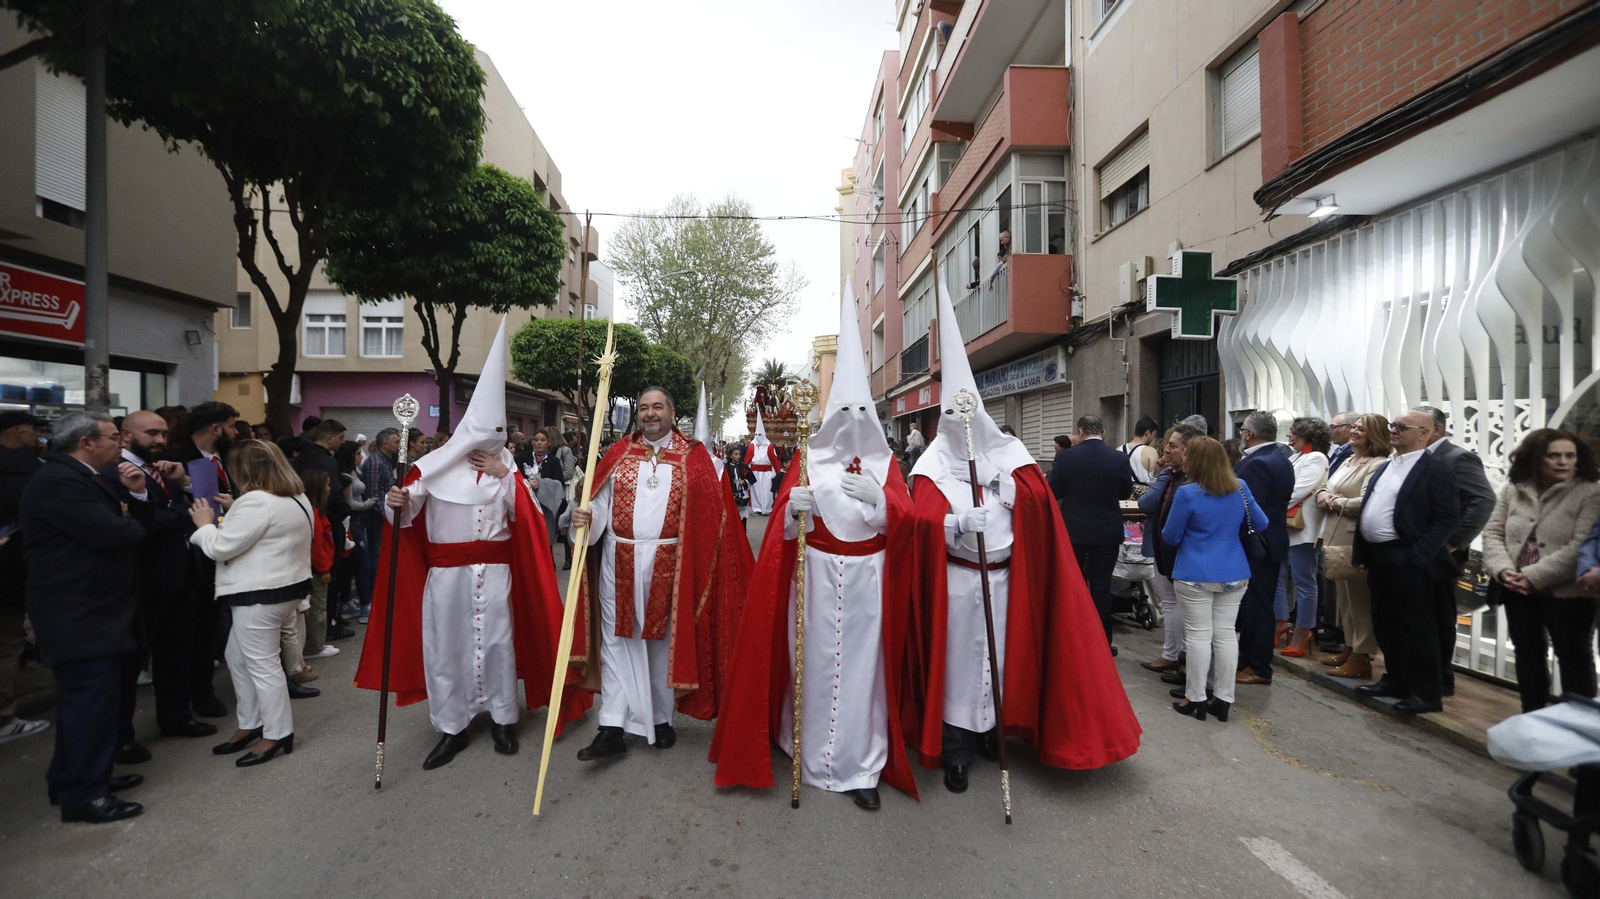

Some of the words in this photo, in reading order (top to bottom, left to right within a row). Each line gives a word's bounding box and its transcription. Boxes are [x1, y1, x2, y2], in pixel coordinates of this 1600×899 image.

[0, 286, 60, 310] XPRESS
[1002, 382, 1016, 394] PARA
[1017, 376, 1041, 389] LLEVAR
